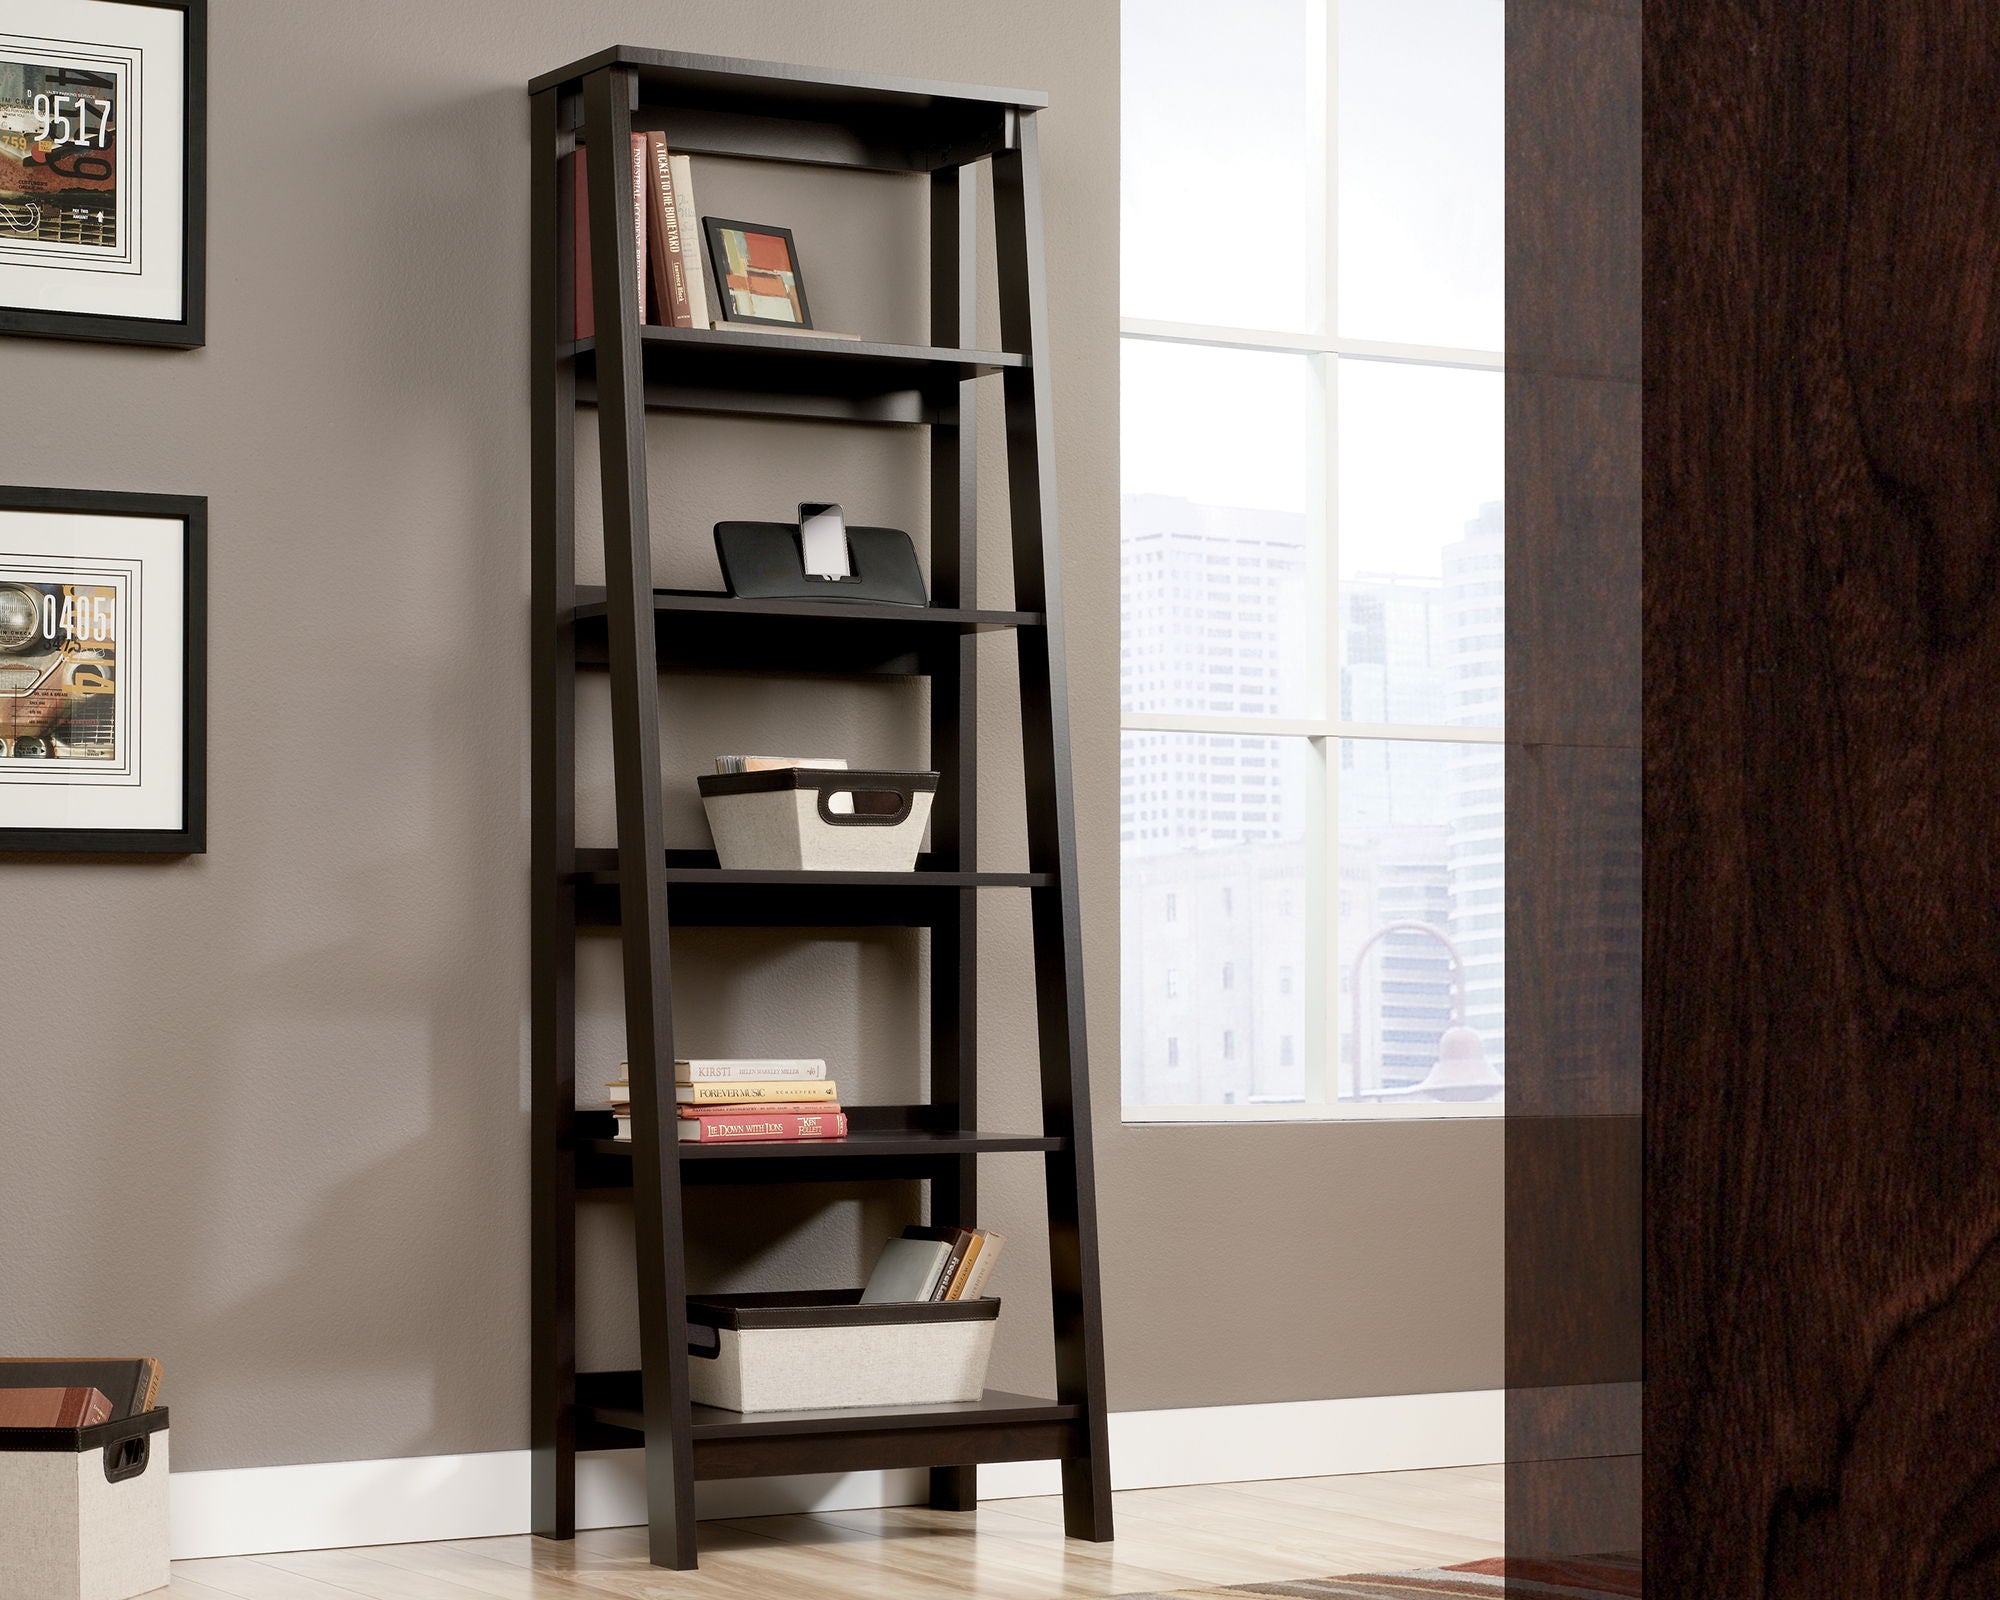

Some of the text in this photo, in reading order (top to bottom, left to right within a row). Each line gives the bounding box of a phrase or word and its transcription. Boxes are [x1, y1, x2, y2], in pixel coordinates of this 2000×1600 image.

[33, 94, 111, 148] 9517
[2, 135, 27, 151] 759
[656, 148, 671, 179] TICKET
[633, 148, 641, 199] INDUSTRIAL
[661, 180, 671, 191] TO
[662, 191, 673, 207] THE
[664, 206, 681, 253] BONEYARD
[698, 1067, 731, 1077] KIRSTI
[700, 1088, 739, 1098] FOREVER
[740, 1088, 766, 1098] MUSIC
[707, 1122, 783, 1136] LIE DOWN WITH LIONS
[803, 1117, 817, 1127] KEN
[798, 1125, 822, 1136] FOLLETT
[947, 1257, 960, 1276] Free
[943, 1275, 949, 1285] at
[934, 1285, 947, 1302] Las
